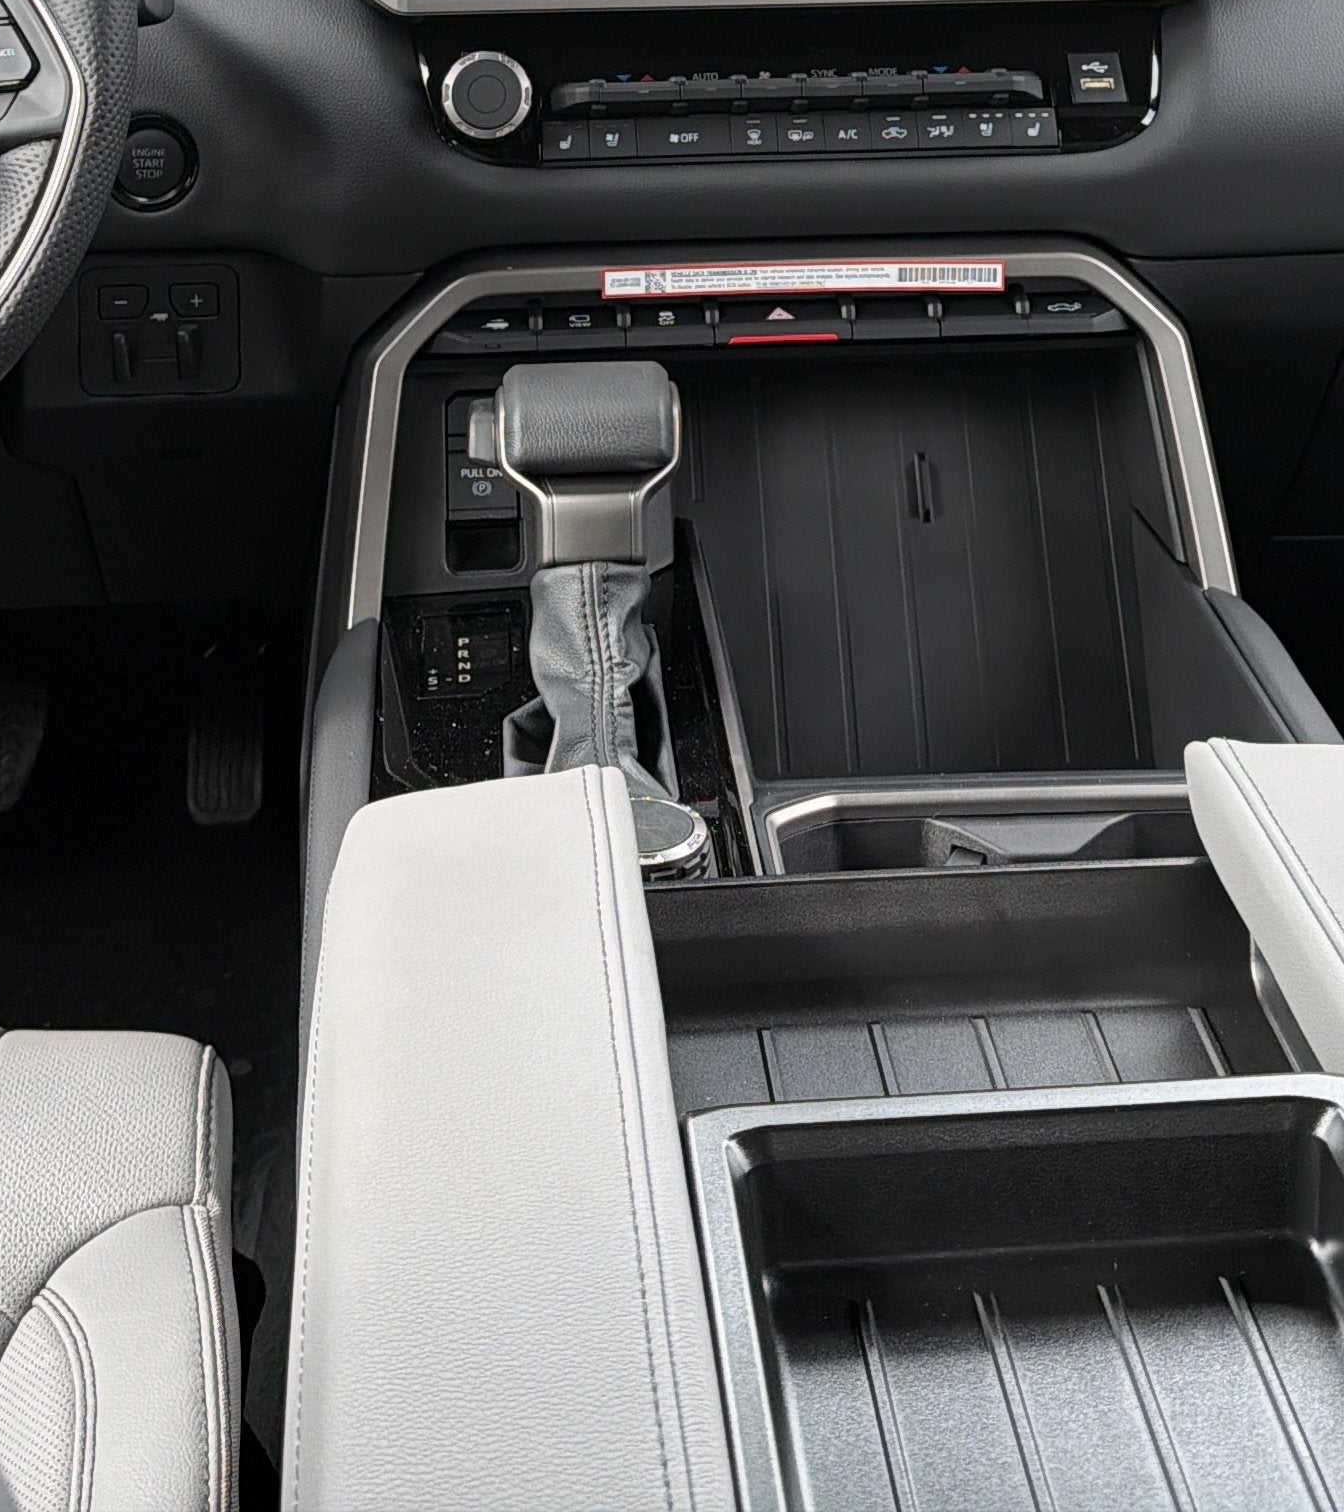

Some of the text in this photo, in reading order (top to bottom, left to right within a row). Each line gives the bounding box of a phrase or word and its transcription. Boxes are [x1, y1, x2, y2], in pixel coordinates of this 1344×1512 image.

[692, 71, 719, 81] AUTO
[810, 68, 837, 78] SYNC
[868, 67, 898, 77] MODE
[680, 132, 699, 143] OFF
[838, 129, 858, 140] A/C
[131, 148, 166, 157] ENGINE
[132, 158, 165, 169] START
[135, 169, 163, 179] STOP
[460, 467, 503, 478] PULL ON
[457, 637, 470, 647] P
[457, 649, 470, 659] R
[457, 661, 471, 671] N
[427, 676, 438, 685] S
[458, 673, 471, 683] D
